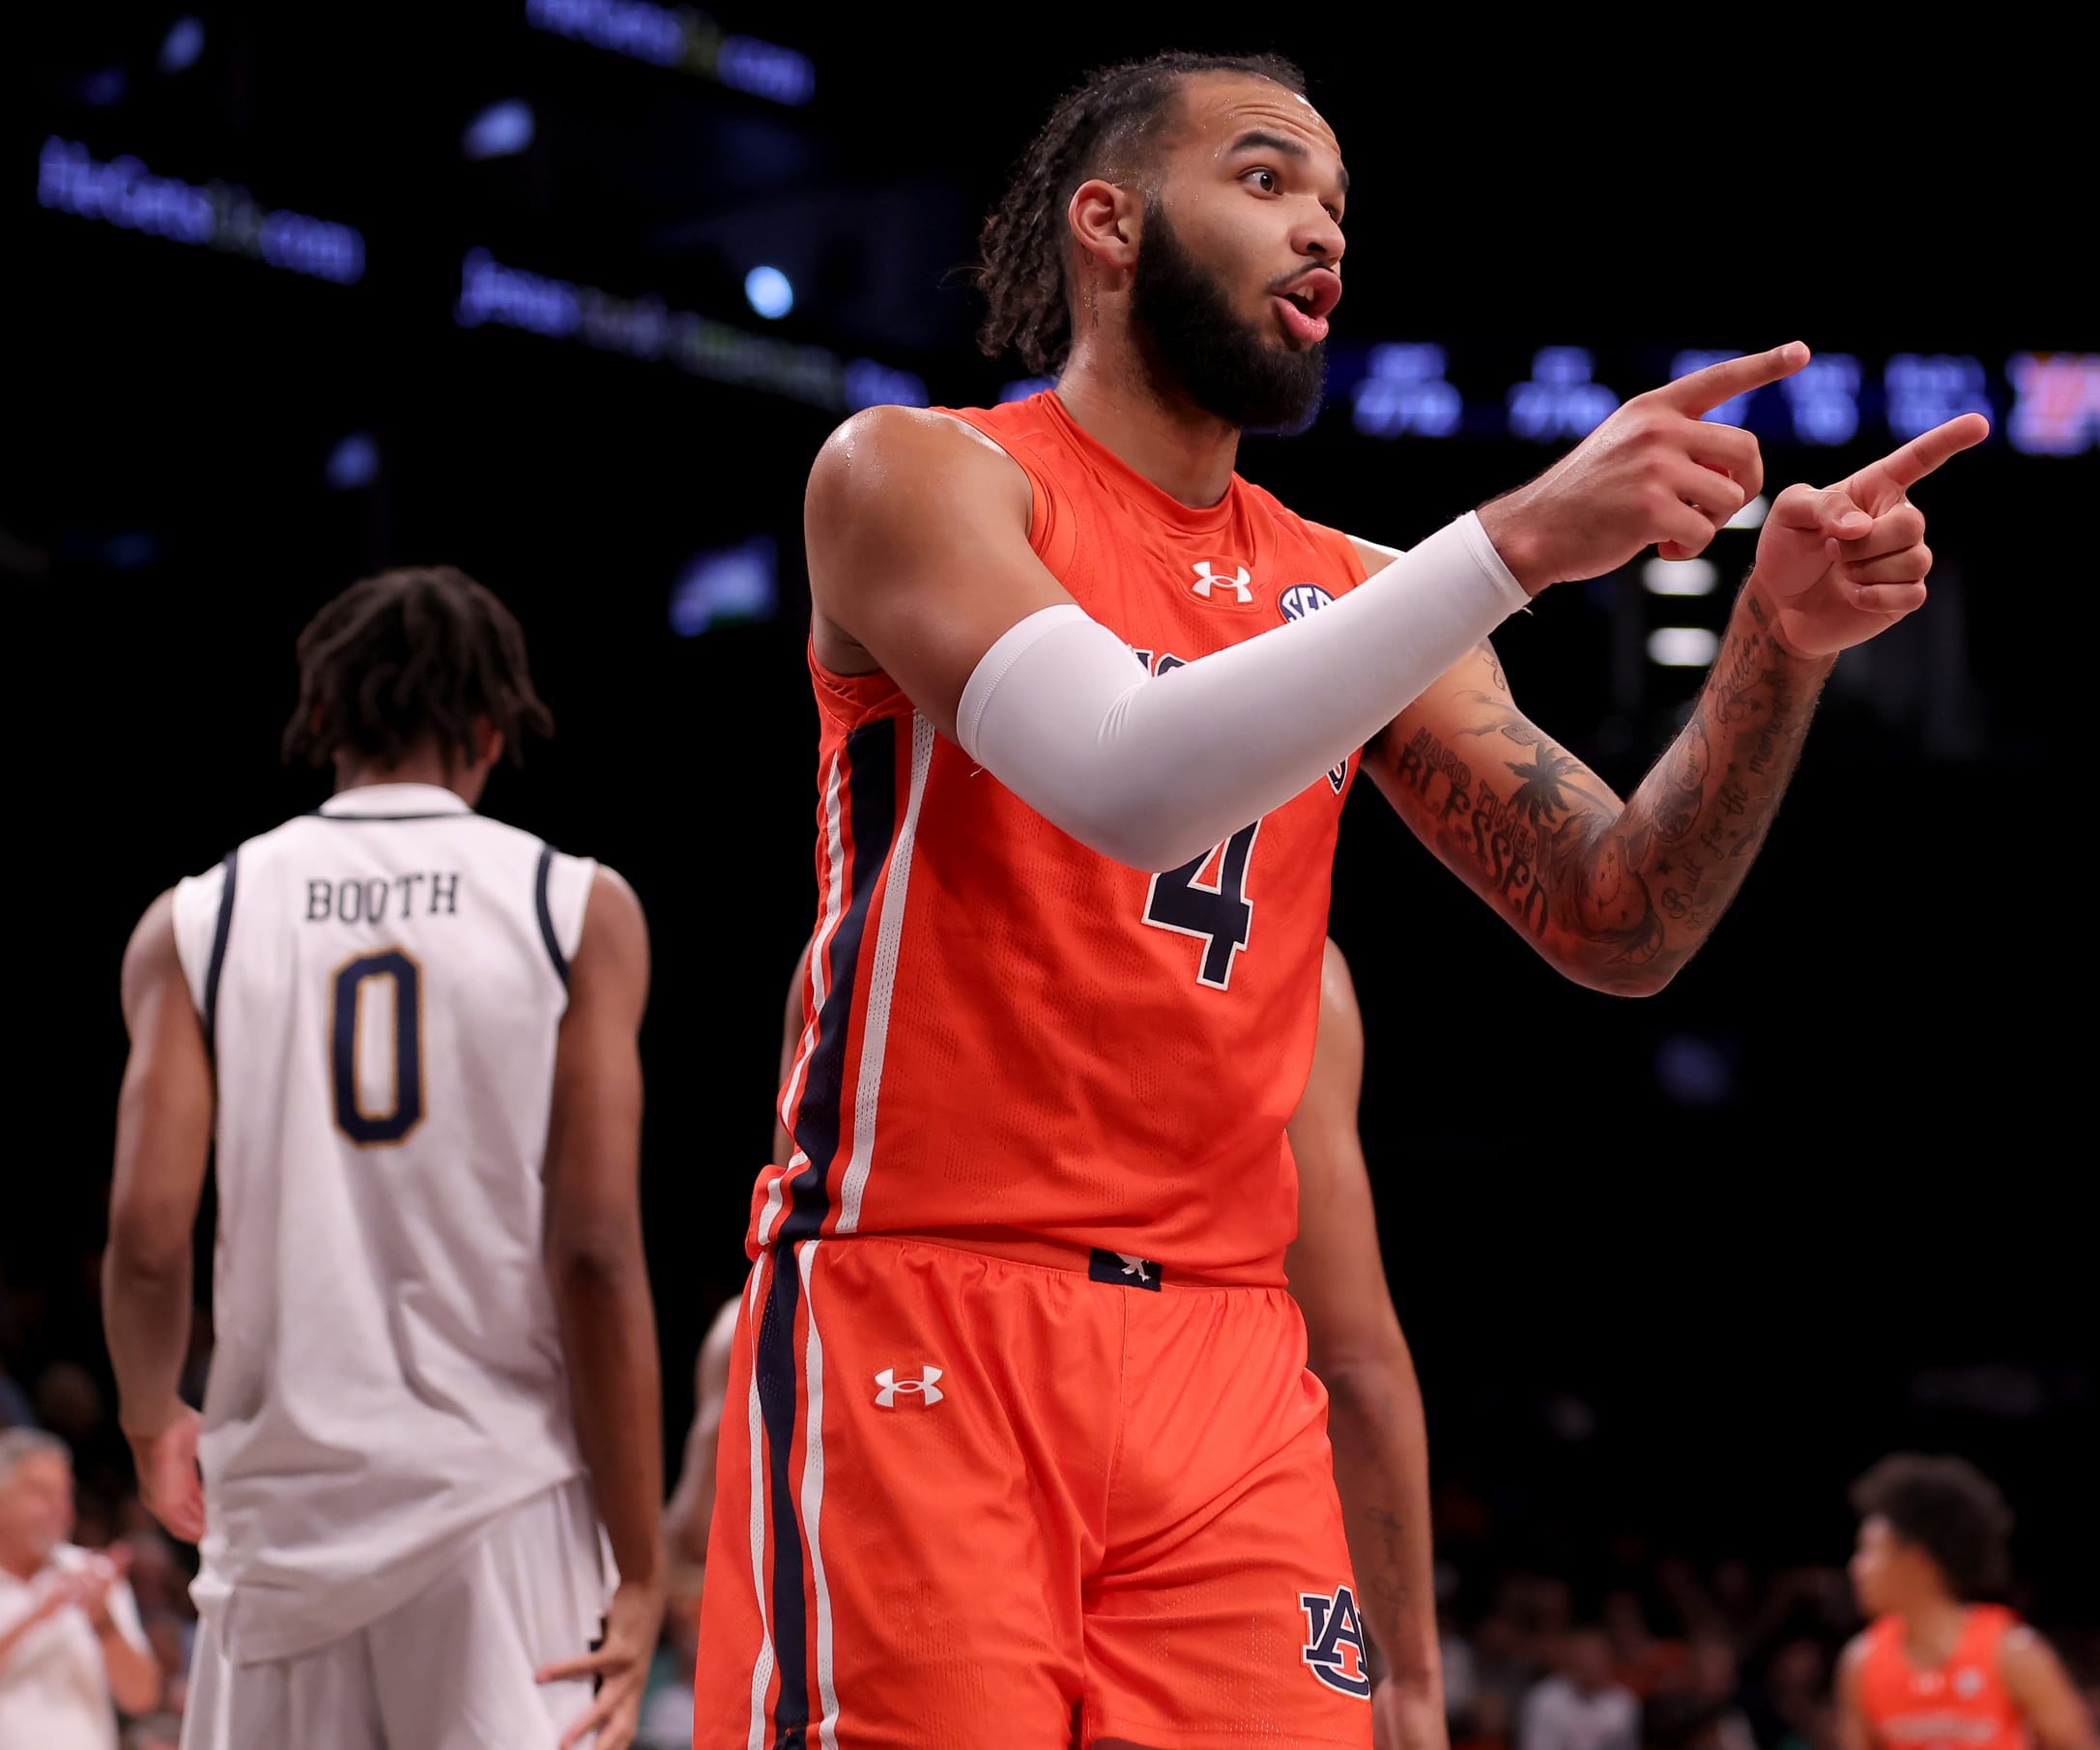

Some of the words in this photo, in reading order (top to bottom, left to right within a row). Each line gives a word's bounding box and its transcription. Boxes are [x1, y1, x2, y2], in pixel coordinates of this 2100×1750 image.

[1410, 726, 1472, 790] HARD
[1477, 779, 1539, 863] TIMES
[303, 872, 460, 926] BOOTH
[1141, 819, 1261, 991] 4
[327, 943, 427, 1151] 0
